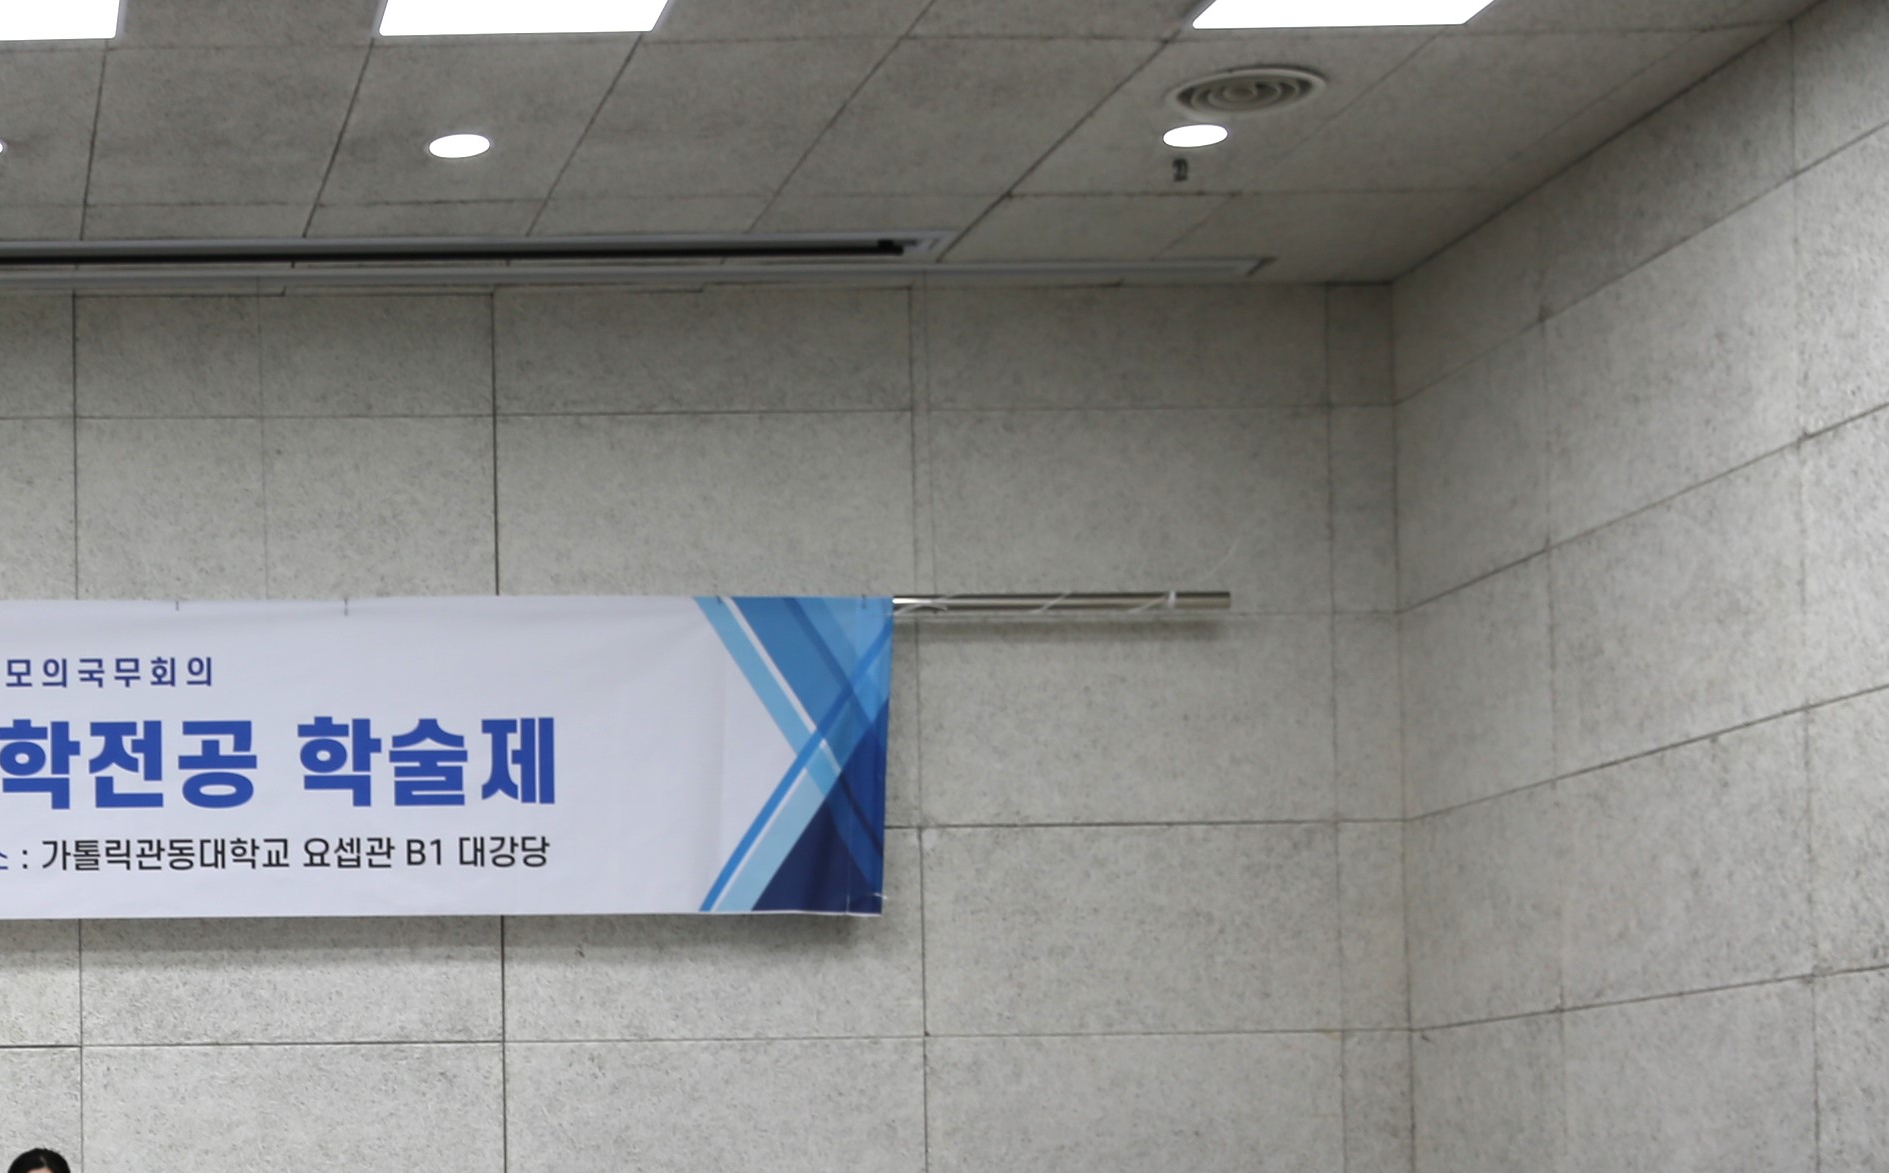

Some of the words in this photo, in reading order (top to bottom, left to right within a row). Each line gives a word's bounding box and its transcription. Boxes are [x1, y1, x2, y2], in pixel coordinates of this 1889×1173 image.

[5, 656, 213, 690] 모의국무회의
[297, 715, 557, 809] 학술제
[42, 837, 291, 872] 가톨릭관동대학교
[303, 836, 397, 870] 요셉관
[406, 838, 443, 867] B1
[458, 835, 552, 869] 대강당
